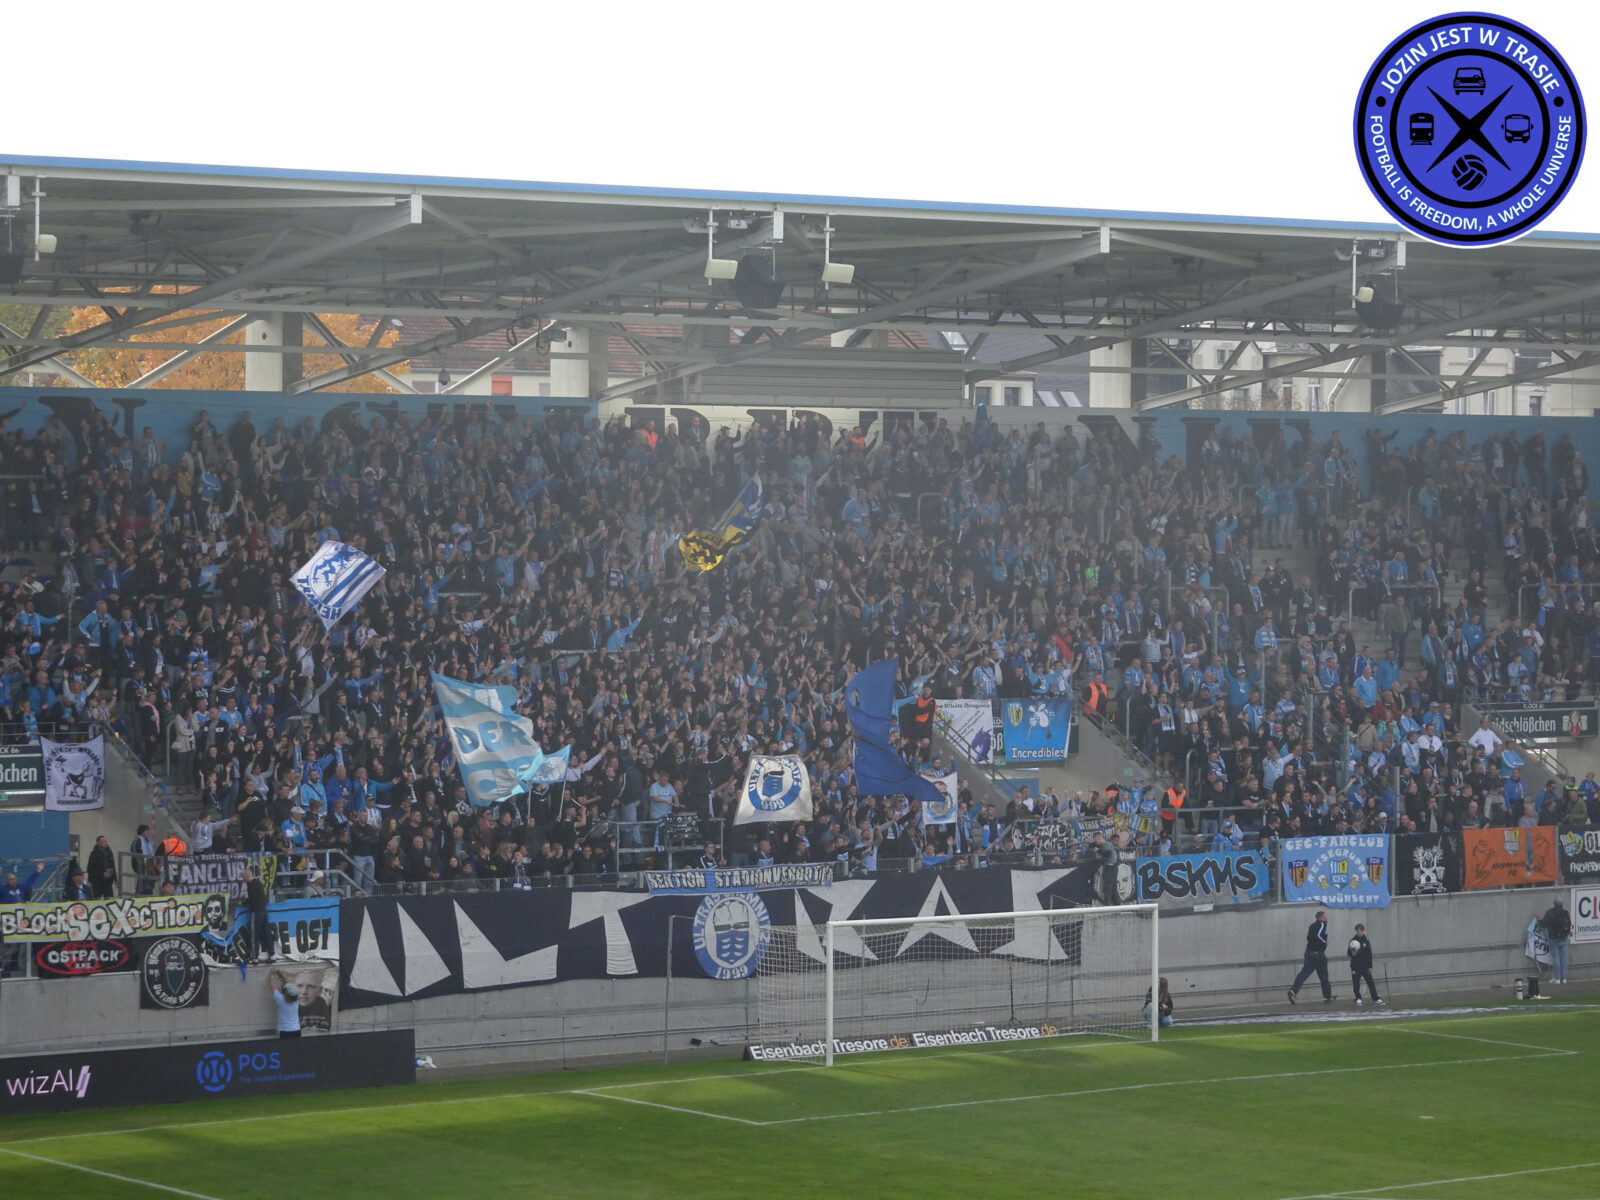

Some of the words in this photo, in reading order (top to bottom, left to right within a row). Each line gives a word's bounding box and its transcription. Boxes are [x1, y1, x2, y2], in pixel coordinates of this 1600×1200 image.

[453, 720, 532, 754] DER
[1011, 747, 1066, 759] Incredibles
[168, 861, 244, 884] FANCLUB
[649, 871, 706, 888] SEKTION
[1138, 856, 1257, 900] BSKMS
[1332, 875, 1346, 883] CFC
[694, 892, 722, 951] ULTRAS
[296, 917, 332, 954] OST
[48, 950, 119, 963] OSTPACK
[715, 964, 749, 980] 1999
[913, 1028, 988, 1048] Eisenbach
[987, 1023, 1059, 1041] Tresore.de
[750, 1039, 827, 1061] Eisenbach
[832, 1035, 909, 1054] Tresore.de
[238, 1052, 281, 1072] POS
